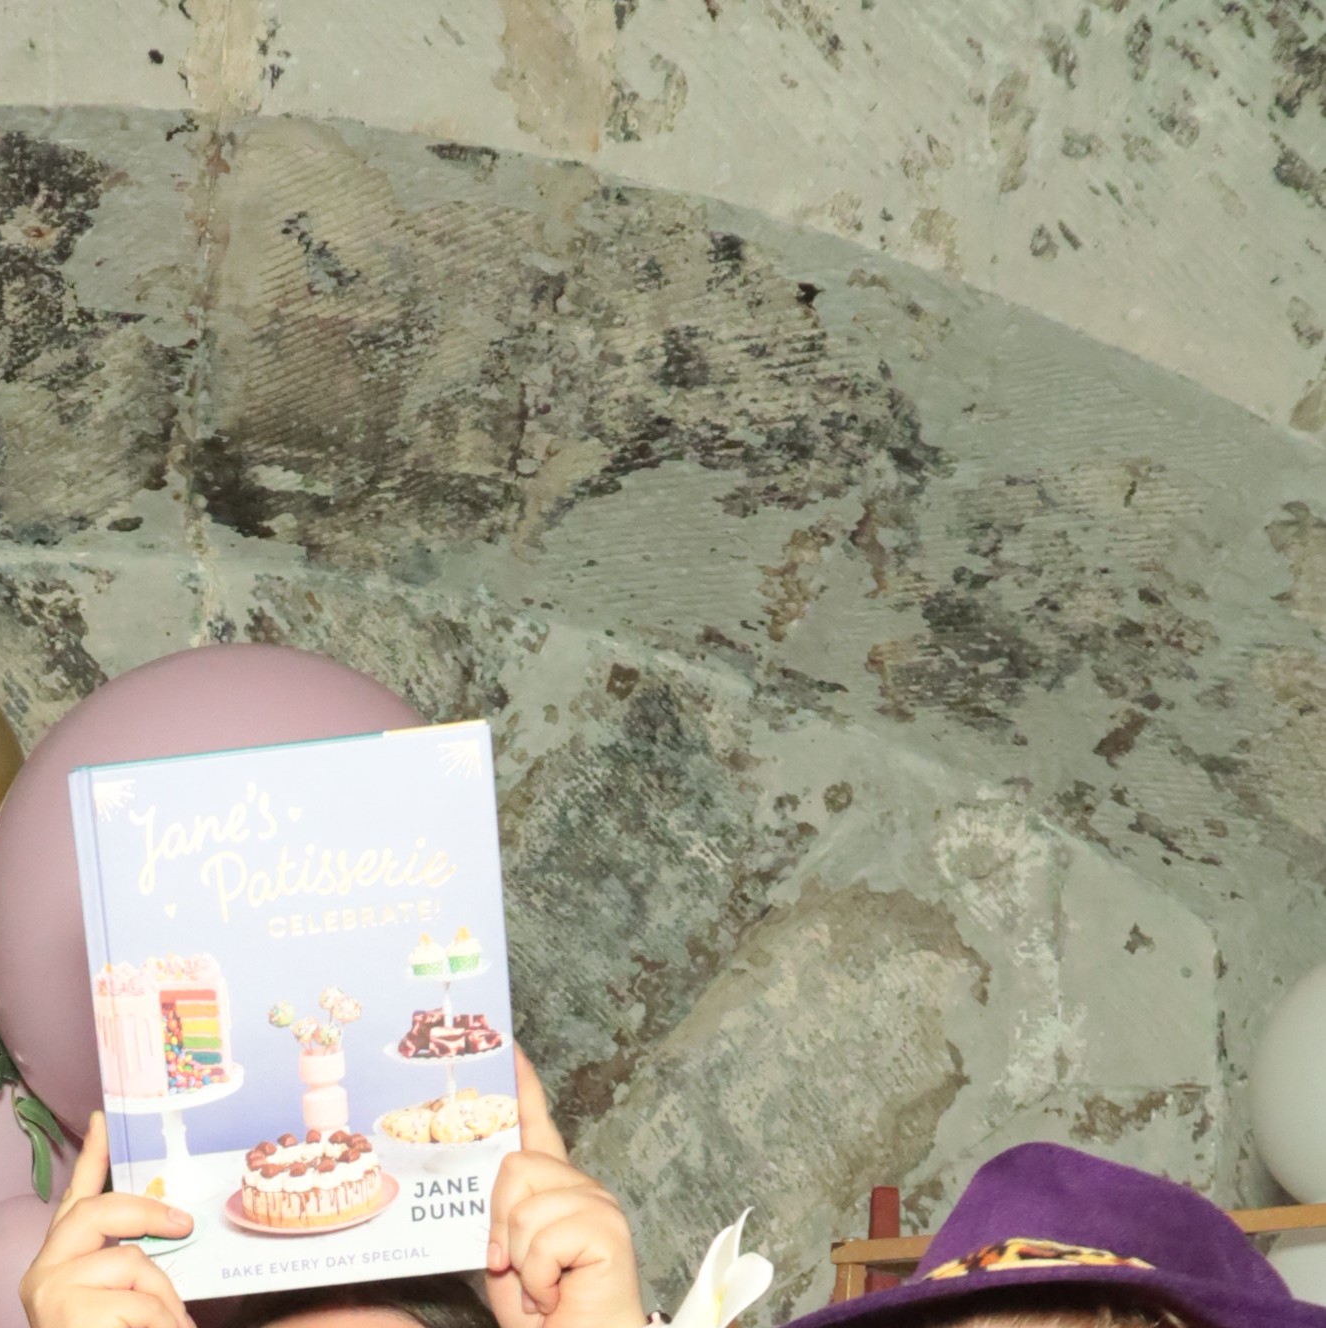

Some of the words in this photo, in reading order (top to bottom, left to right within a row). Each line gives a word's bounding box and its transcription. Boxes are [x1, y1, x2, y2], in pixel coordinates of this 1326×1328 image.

[128, 781, 278, 895] Jane's
[200, 836, 458, 924] Patisserie
[267, 899, 442, 938] CELEBRATE!
[413, 1176, 480, 1199] JANE
[410, 1198, 486, 1222] DUNN
[221, 1264, 264, 1280] BAKE
[269, 1258, 320, 1275] EVERY
[326, 1254, 356, 1268] DAY
[362, 1247, 430, 1264] SPECIAL
